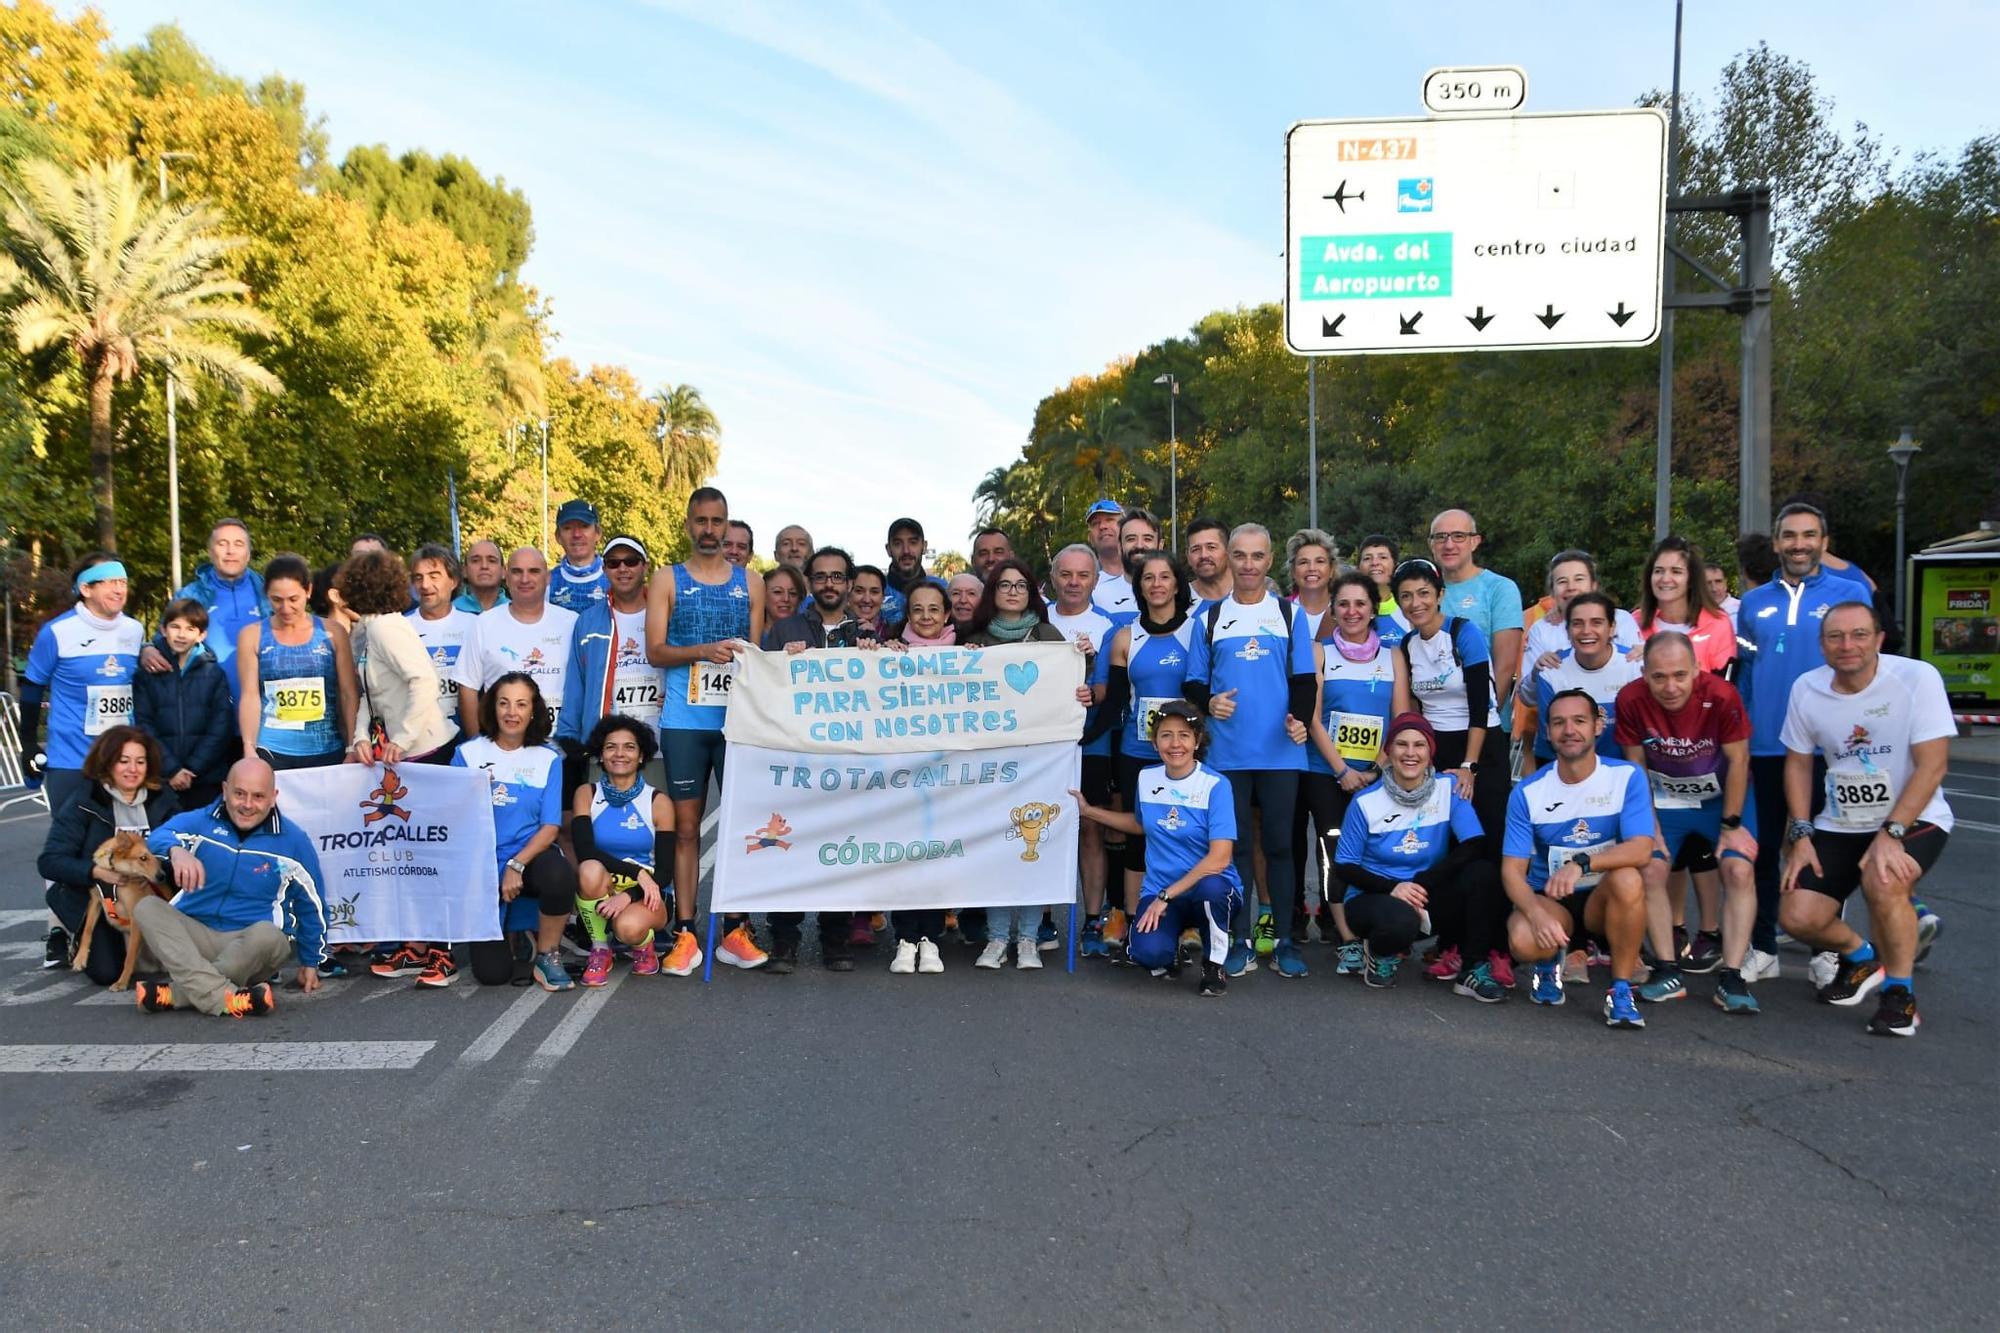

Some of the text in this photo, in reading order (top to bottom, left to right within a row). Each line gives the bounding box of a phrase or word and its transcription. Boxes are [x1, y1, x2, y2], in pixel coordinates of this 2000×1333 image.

[1439, 82, 1511, 101] 350 m
[1343, 139, 1413, 160] N-437
[1323, 239, 1430, 262] Avda. del
[1474, 235, 1637, 257] centro ciudad
[1313, 272, 1441, 297] Aeropuerto
[1949, 600, 1989, 609] FRIDAY
[790, 657, 866, 684] PACO
[99, 697, 133, 713] 3886
[276, 690, 321, 707] 3875
[616, 686, 658, 703] 4772
[794, 690, 871, 715] PARA
[810, 720, 864, 742] CON
[1338, 725, 1378, 746] 3891
[1660, 737, 1694, 748] MEDIA
[1660, 738, 1713, 757] MARATON
[769, 761, 1019, 791] TROTACALLES
[1663, 782, 1716, 794] 3234
[1837, 783, 1890, 804] 3882
[319, 824, 449, 851] TROTACALLES
[368, 850, 415, 862] CLUB
[818, 836, 965, 866] CÓRDOBA
[343, 864, 438, 878] ATLETISMO CÓRDOBA
